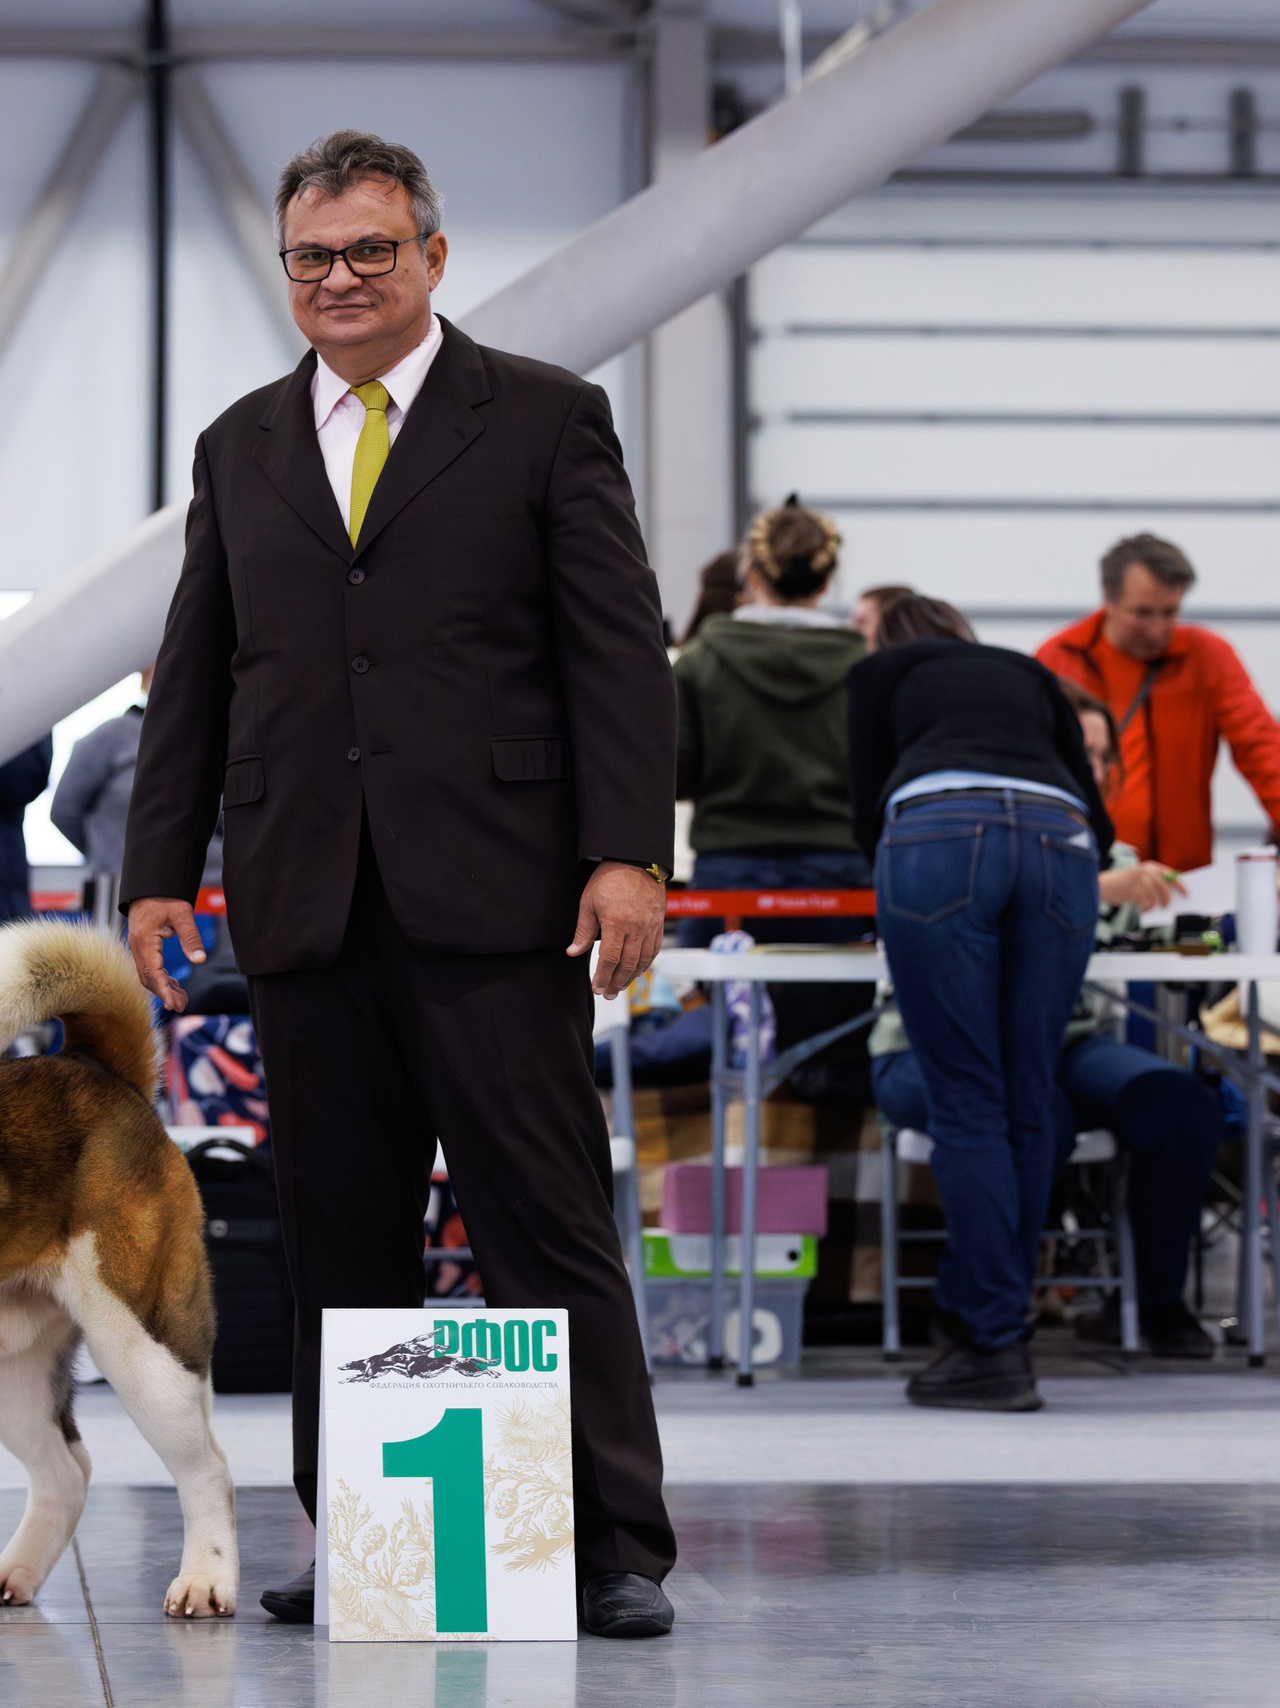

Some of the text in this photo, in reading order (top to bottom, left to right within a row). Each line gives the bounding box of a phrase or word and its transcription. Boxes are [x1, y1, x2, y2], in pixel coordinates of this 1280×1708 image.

[433, 1318, 558, 1372] РФОС
[369, 1381, 559, 1389] ФЕДЕРАЦИЯ ОХОТНИЧЬЕГО СОБАКОВОДСТВА
[382, 1408, 488, 1633] 1
